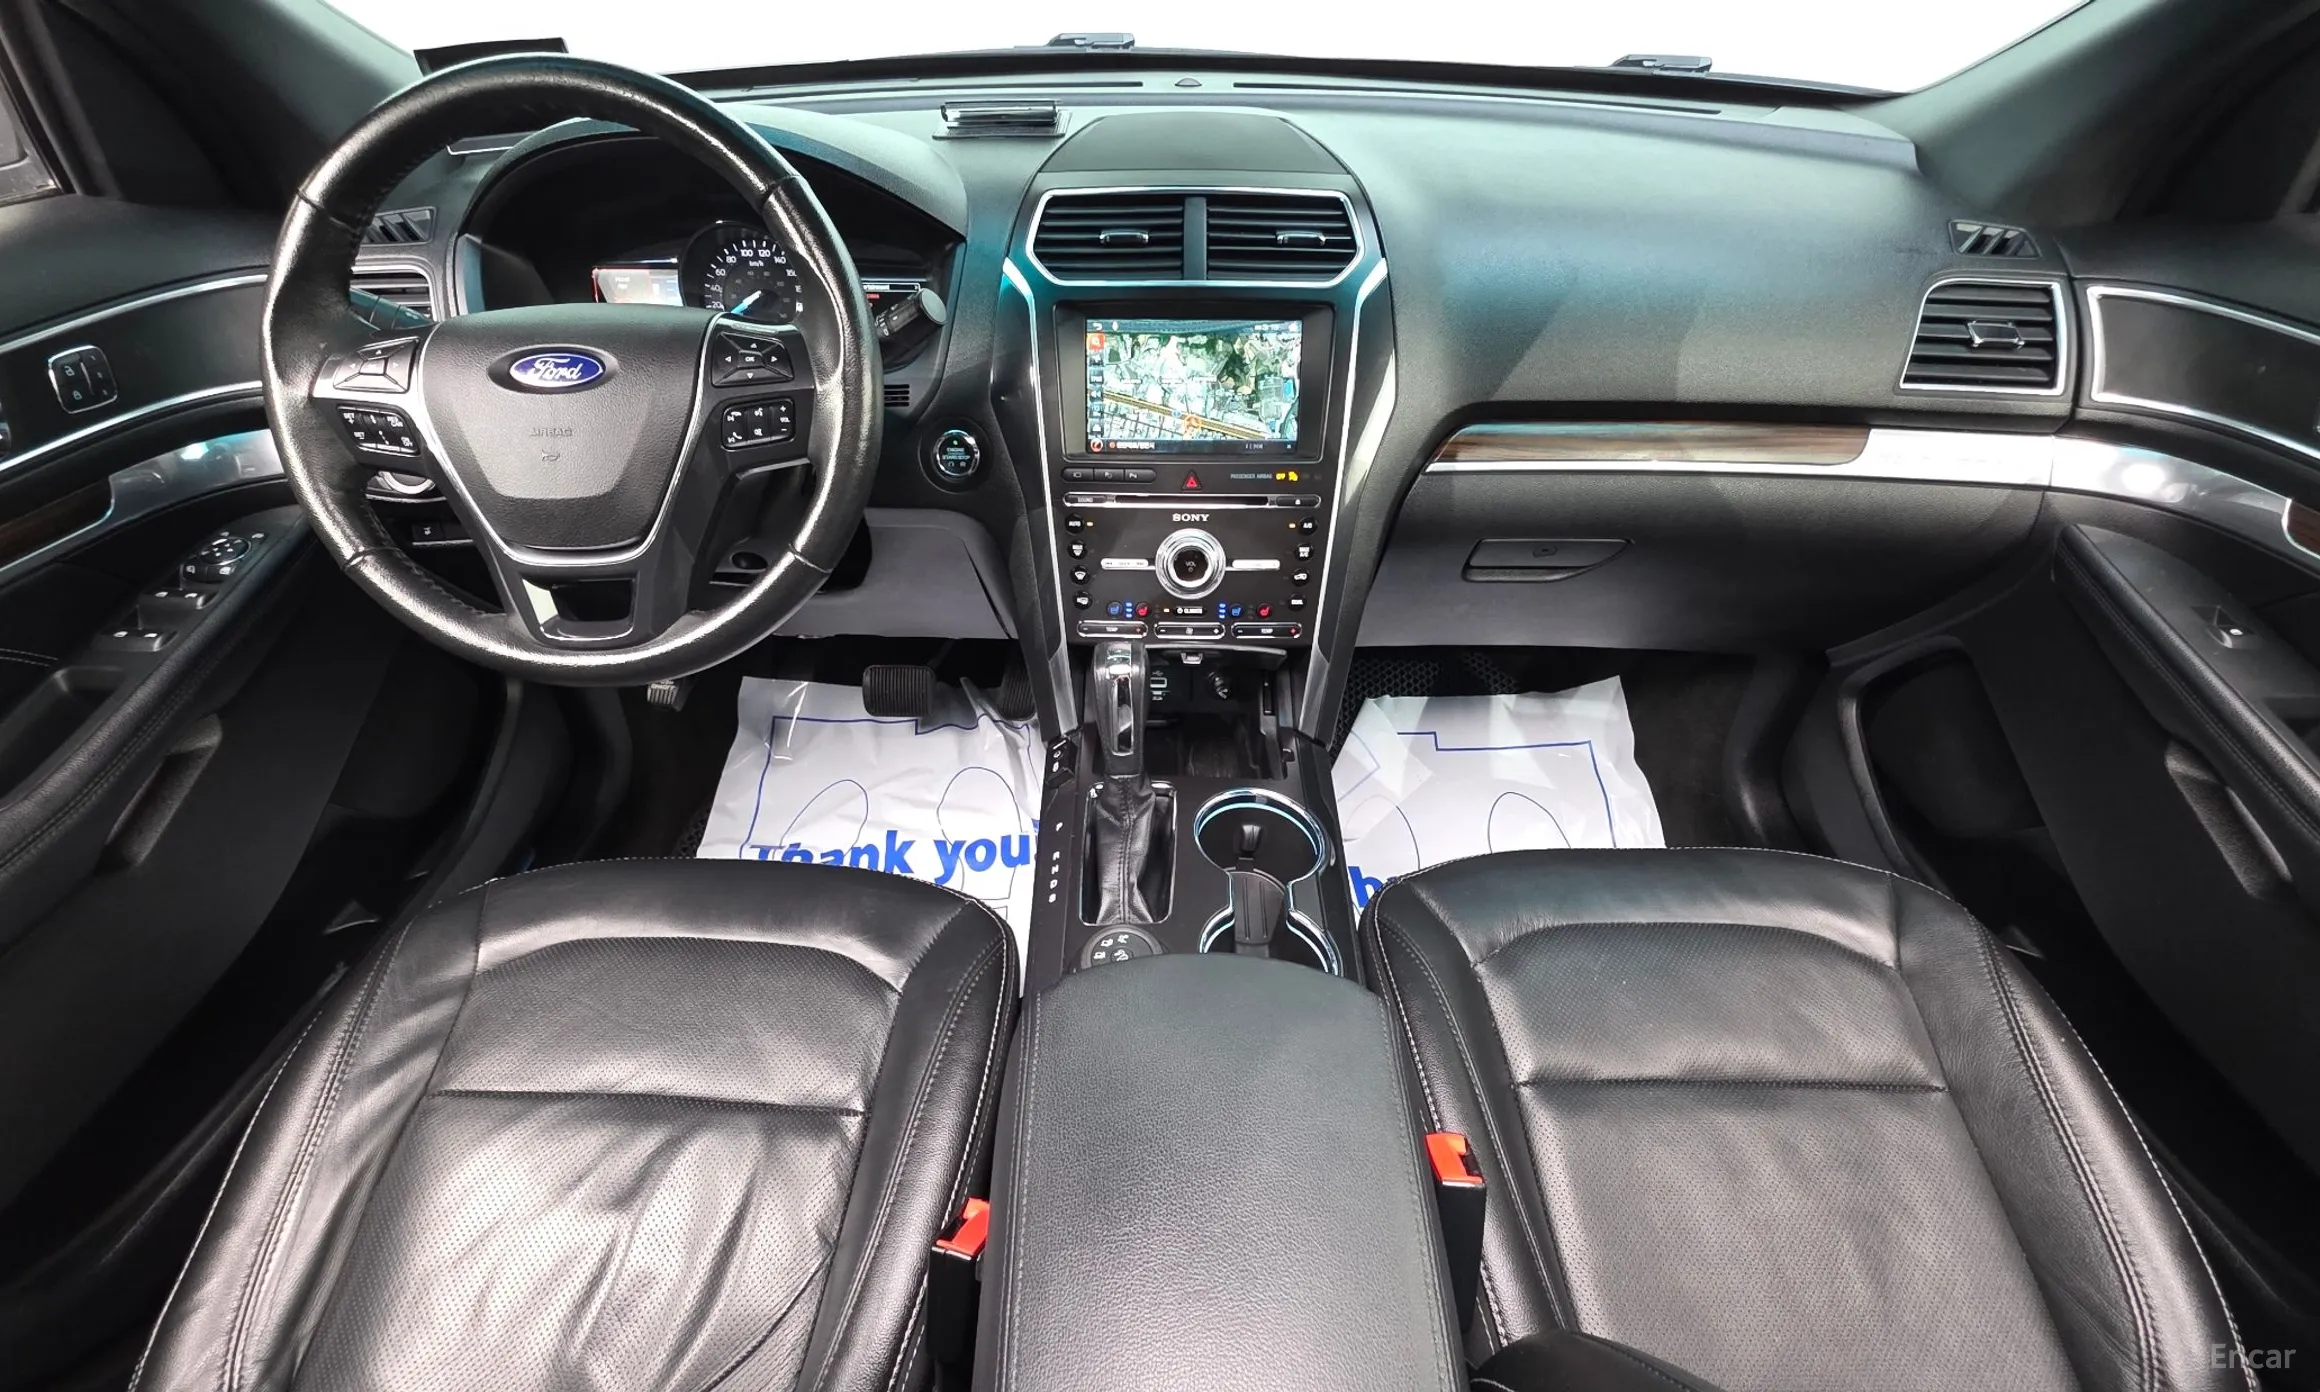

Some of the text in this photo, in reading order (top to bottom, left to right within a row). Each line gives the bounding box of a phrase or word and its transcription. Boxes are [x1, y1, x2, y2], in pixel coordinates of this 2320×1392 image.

[740, 249, 753, 257] 100
[758, 249, 771, 257] 120
[726, 256, 737, 264] 80
[774, 256, 786, 264] 140
[715, 268, 726, 276] 60
[712, 301, 722, 309] 20
[533, 357, 583, 380] Ford
[343, 412, 355, 420] SET
[529, 427, 573, 437] AIRBAG
[1172, 513, 1210, 522] SONY
[934, 817, 1039, 885] you
[1051, 864, 1059, 875] N
[1049, 879, 1058, 889] D
